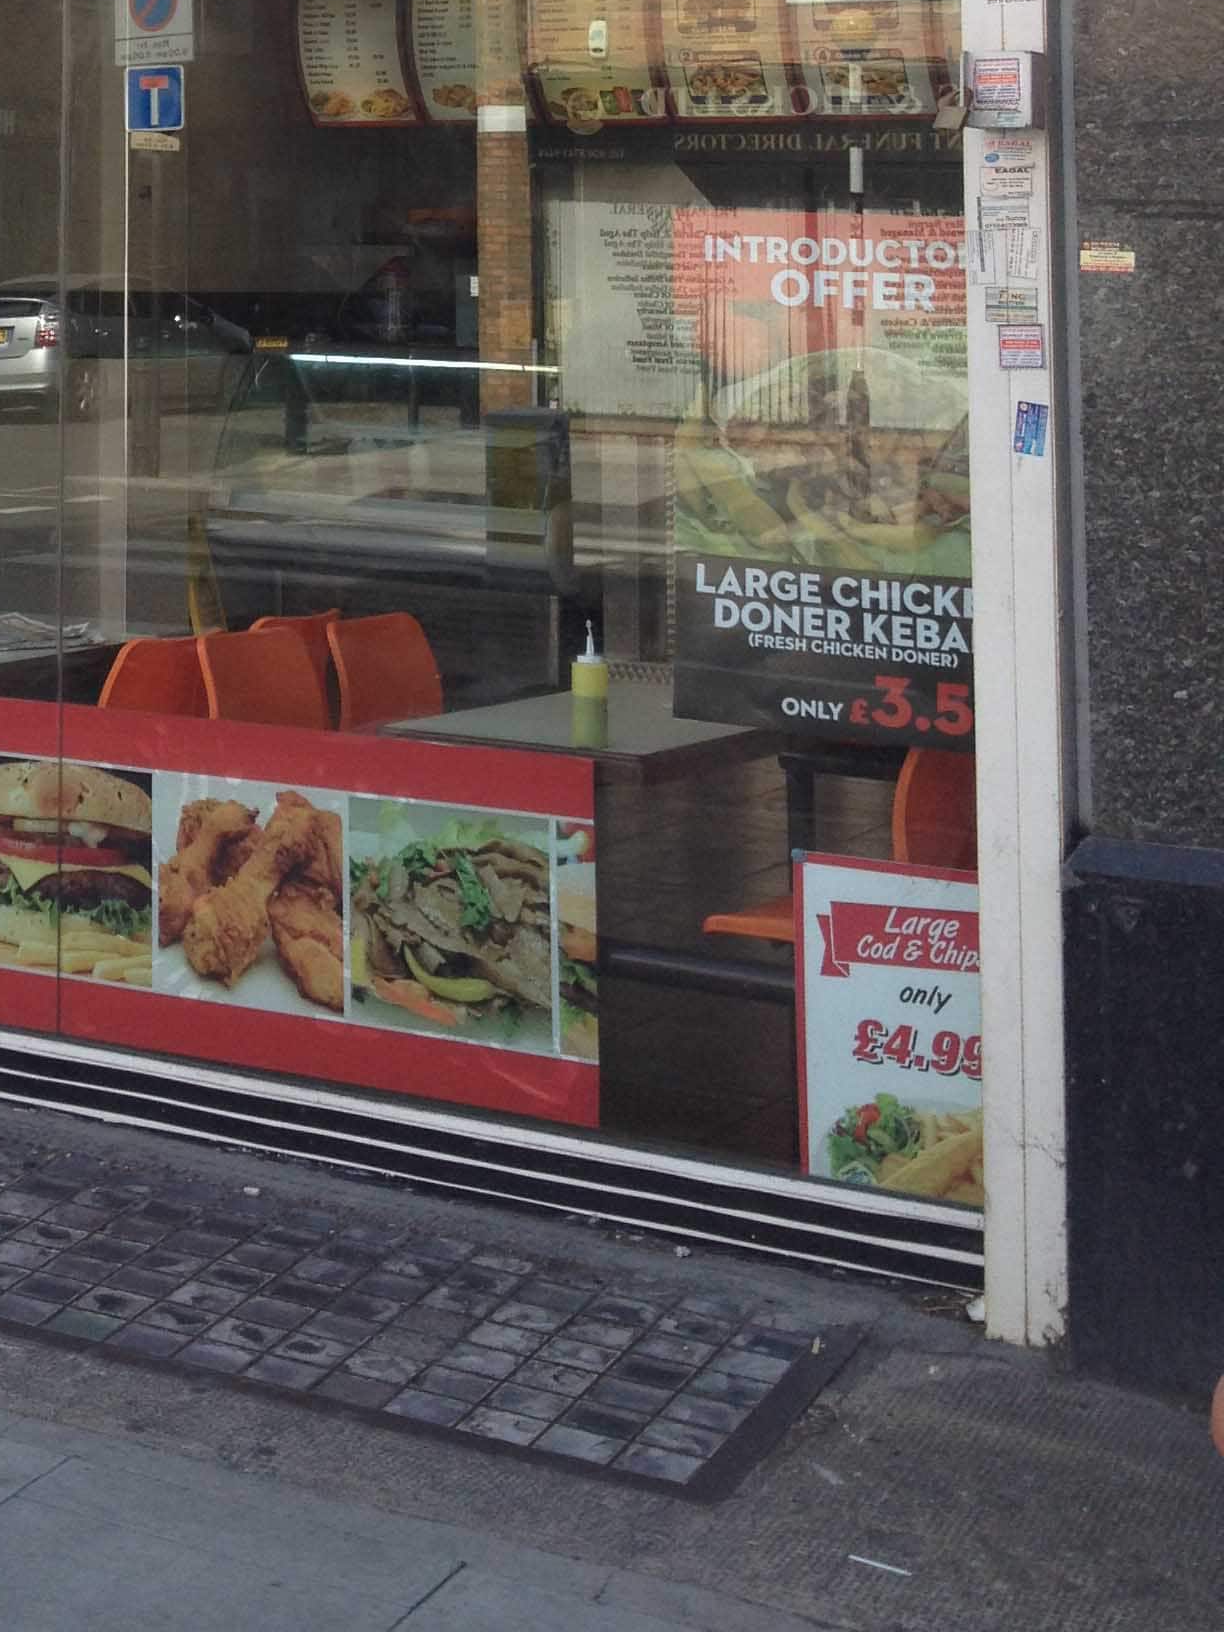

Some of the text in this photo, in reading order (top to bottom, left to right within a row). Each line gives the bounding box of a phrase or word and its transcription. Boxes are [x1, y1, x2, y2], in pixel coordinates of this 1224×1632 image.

[770, 269, 937, 312] OFFER
[695, 563, 821, 604] LARGE
[713, 598, 974, 655] DONER KEBA
[748, 633, 958, 669] (FRESH CHICKEN DONER)
[781, 673, 974, 737] ONLY £3.5
[884, 907, 960, 944] Large
[856, 933, 980, 972] Cod & Chip
[899, 985, 952, 1014] only
